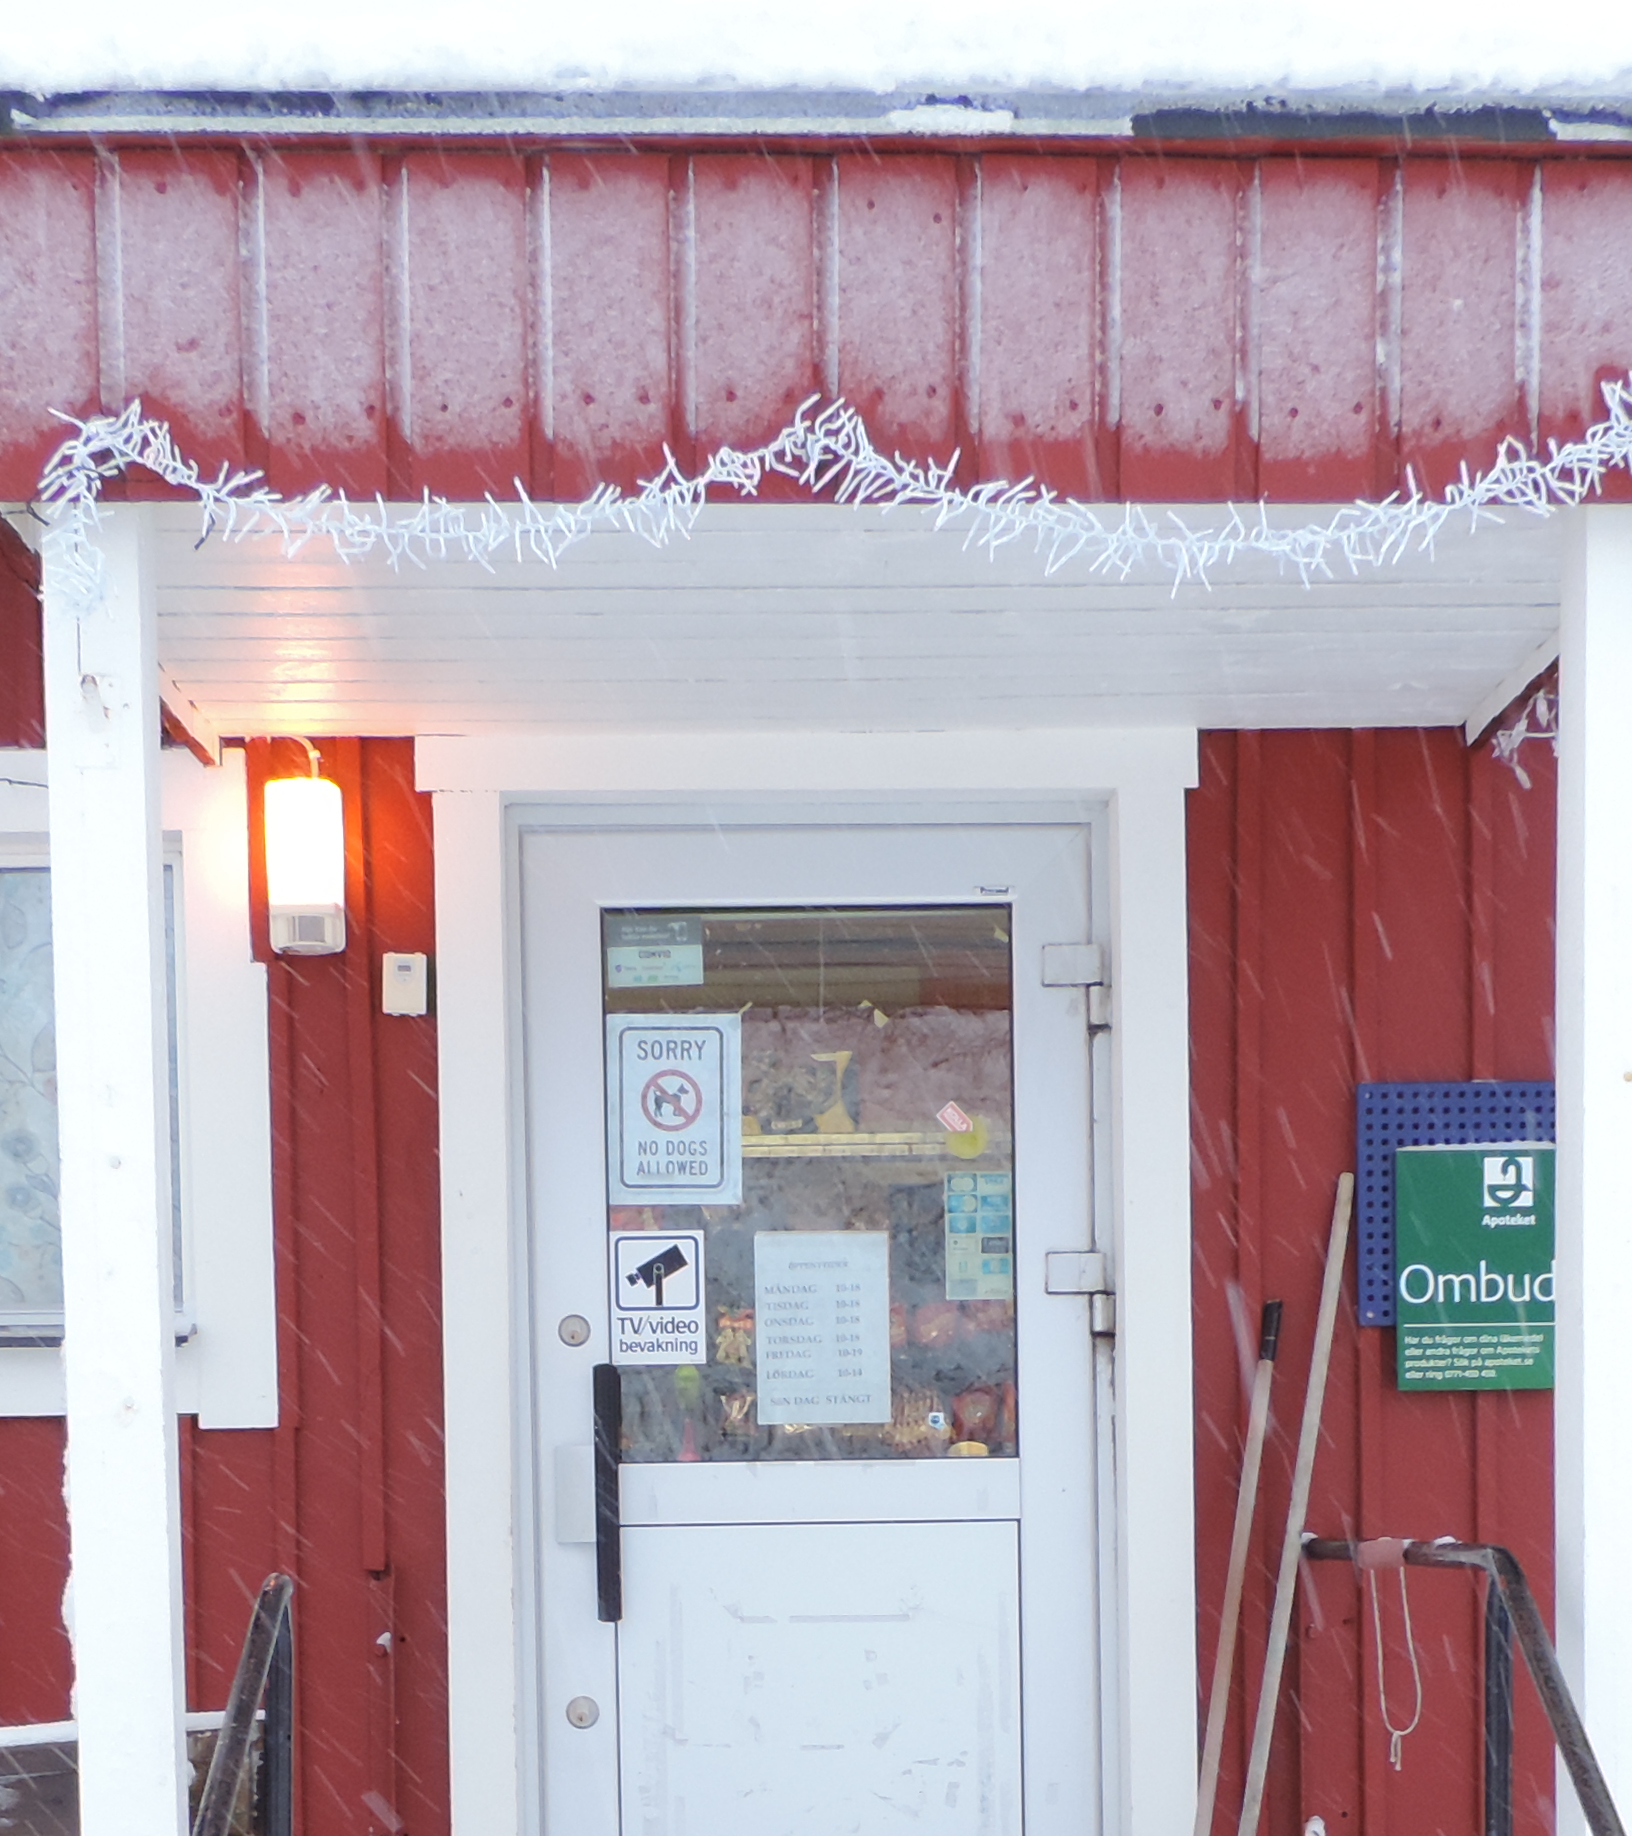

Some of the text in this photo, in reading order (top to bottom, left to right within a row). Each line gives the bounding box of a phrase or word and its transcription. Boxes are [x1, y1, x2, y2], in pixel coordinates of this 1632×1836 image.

[637, 1039, 707, 1061] SORRY
[638, 1140, 708, 1156] NO DOGS
[636, 1160, 709, 1176] ALLOWED
[1482, 1213, 1536, 1228] Apoteket
[764, 1283, 861, 1295] MÅNDAG 10-18
[1399, 1259, 1556, 1304] Ombud
[766, 1300, 861, 1311] TISDAG 10-18
[616, 1314, 699, 1336] TV/video
[764, 1315, 861, 1327] ONSDAG 10-18
[619, 1337, 698, 1355] bevakning
[766, 1333, 861, 1345] TORSDAG 10-18
[765, 1349, 812, 1360] FREDAG
[766, 1367, 863, 1380] LÖRDAG 10-14
